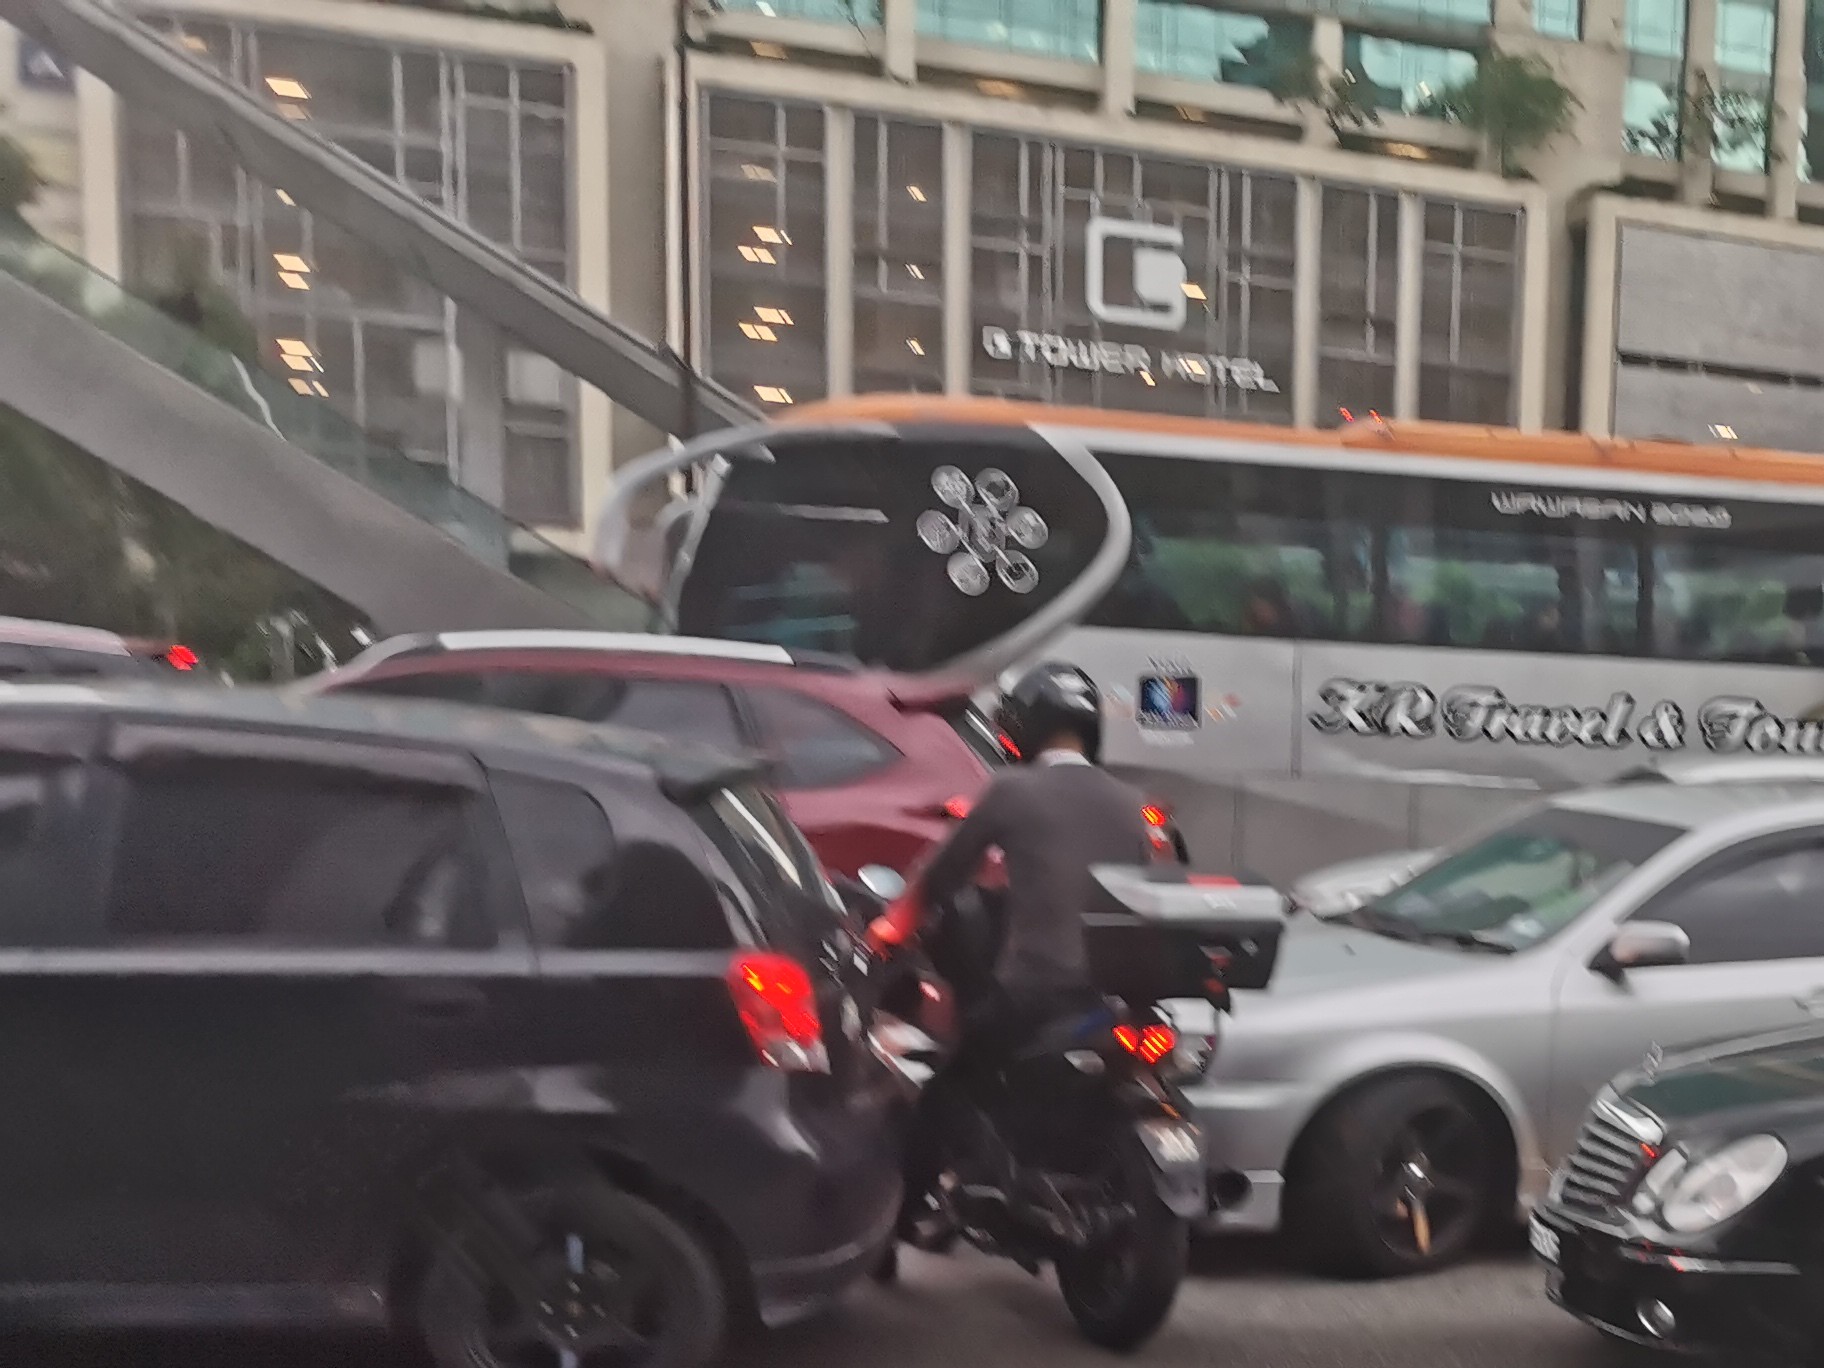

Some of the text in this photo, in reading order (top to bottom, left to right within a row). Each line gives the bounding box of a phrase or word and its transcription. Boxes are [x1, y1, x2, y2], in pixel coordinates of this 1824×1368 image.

[1016, 329, 1152, 376] TOWER
[1160, 349, 1281, 394] HOTEL
[1440, 683, 1637, 748] Travel
[1636, 699, 1687, 749] &
